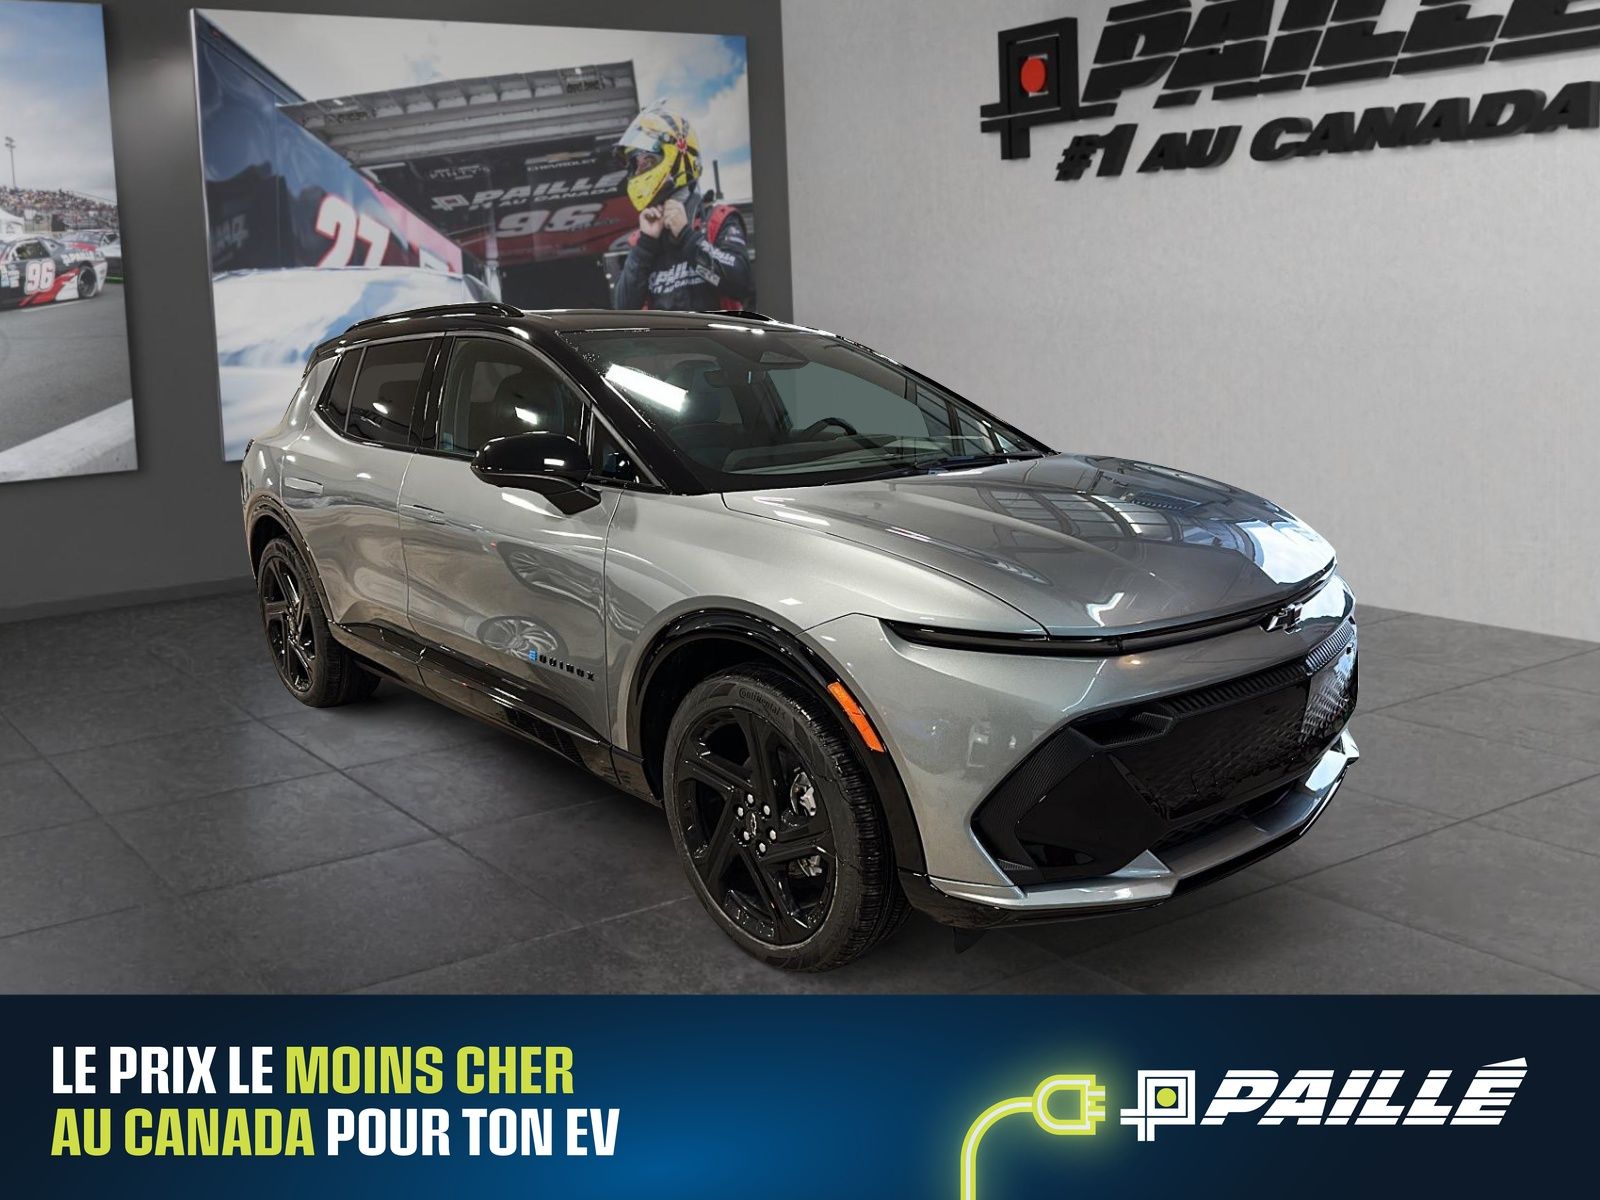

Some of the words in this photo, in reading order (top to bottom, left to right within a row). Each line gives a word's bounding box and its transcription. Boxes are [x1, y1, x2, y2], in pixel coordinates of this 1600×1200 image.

[1055, 123, 1138, 181] #1
[1136, 125, 1243, 174] AU
[1250, 80, 1600, 162] CANADA
[495, 202, 604, 238] 96
[24, 258, 56, 296] 96
